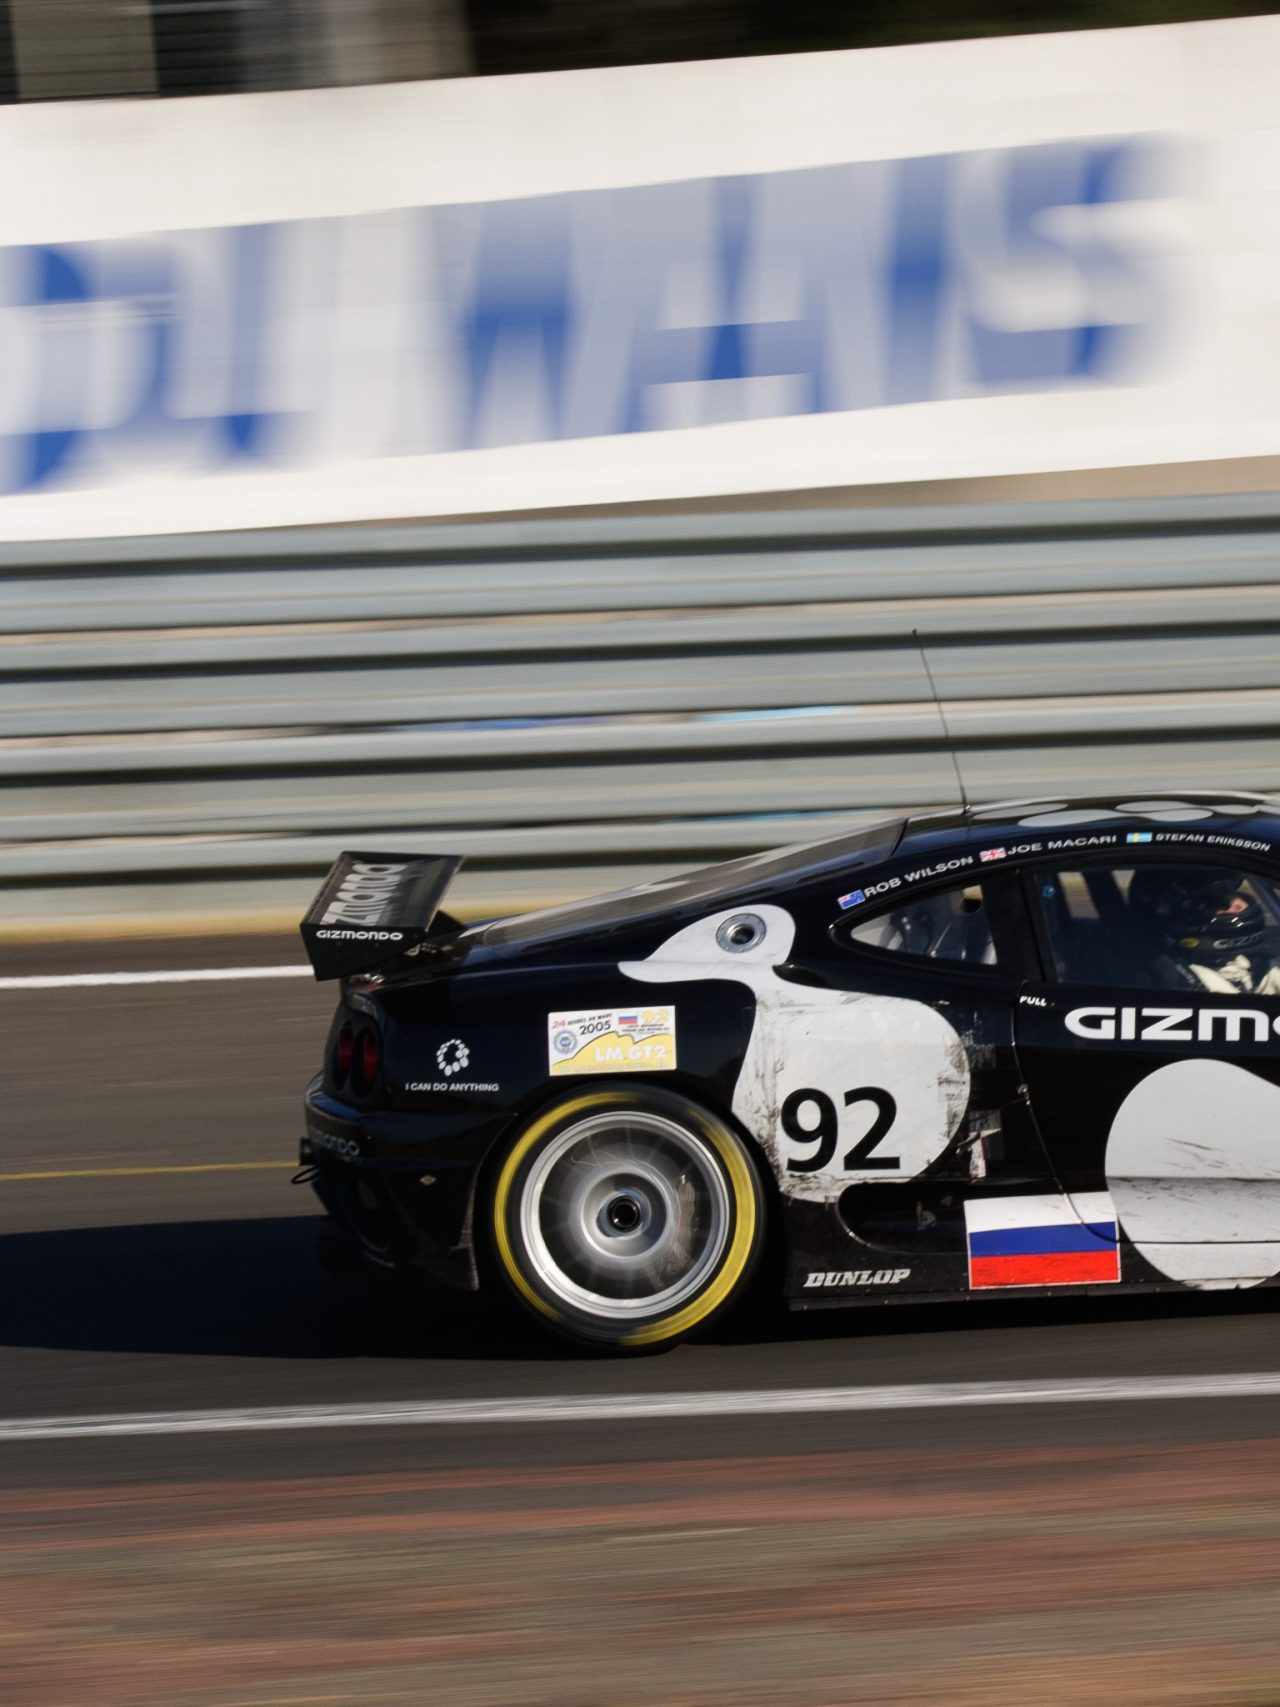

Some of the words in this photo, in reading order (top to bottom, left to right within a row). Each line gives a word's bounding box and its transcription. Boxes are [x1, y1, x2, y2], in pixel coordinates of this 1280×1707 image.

[1007, 841, 1042, 856] JOE
[1048, 834, 1117, 850] MACARI
[1155, 832, 1205, 843] STEFAN
[1207, 834, 1271, 852] ERIKSSON
[864, 877, 901, 898] ROB
[904, 855, 974, 882] WILSON
[316, 930, 403, 941] GIZMONDO
[1020, 995, 1047, 1007] PULL
[579, 1020, 612, 1036] 2005
[405, 1083, 410, 1091] I
[410, 1083, 432, 1091] CAN
[433, 1083, 448, 1091] DO
[449, 1083, 500, 1092] ANYTHING
[780, 1086, 901, 1174] 92
[803, 1268, 911, 1288] DUNLOP
